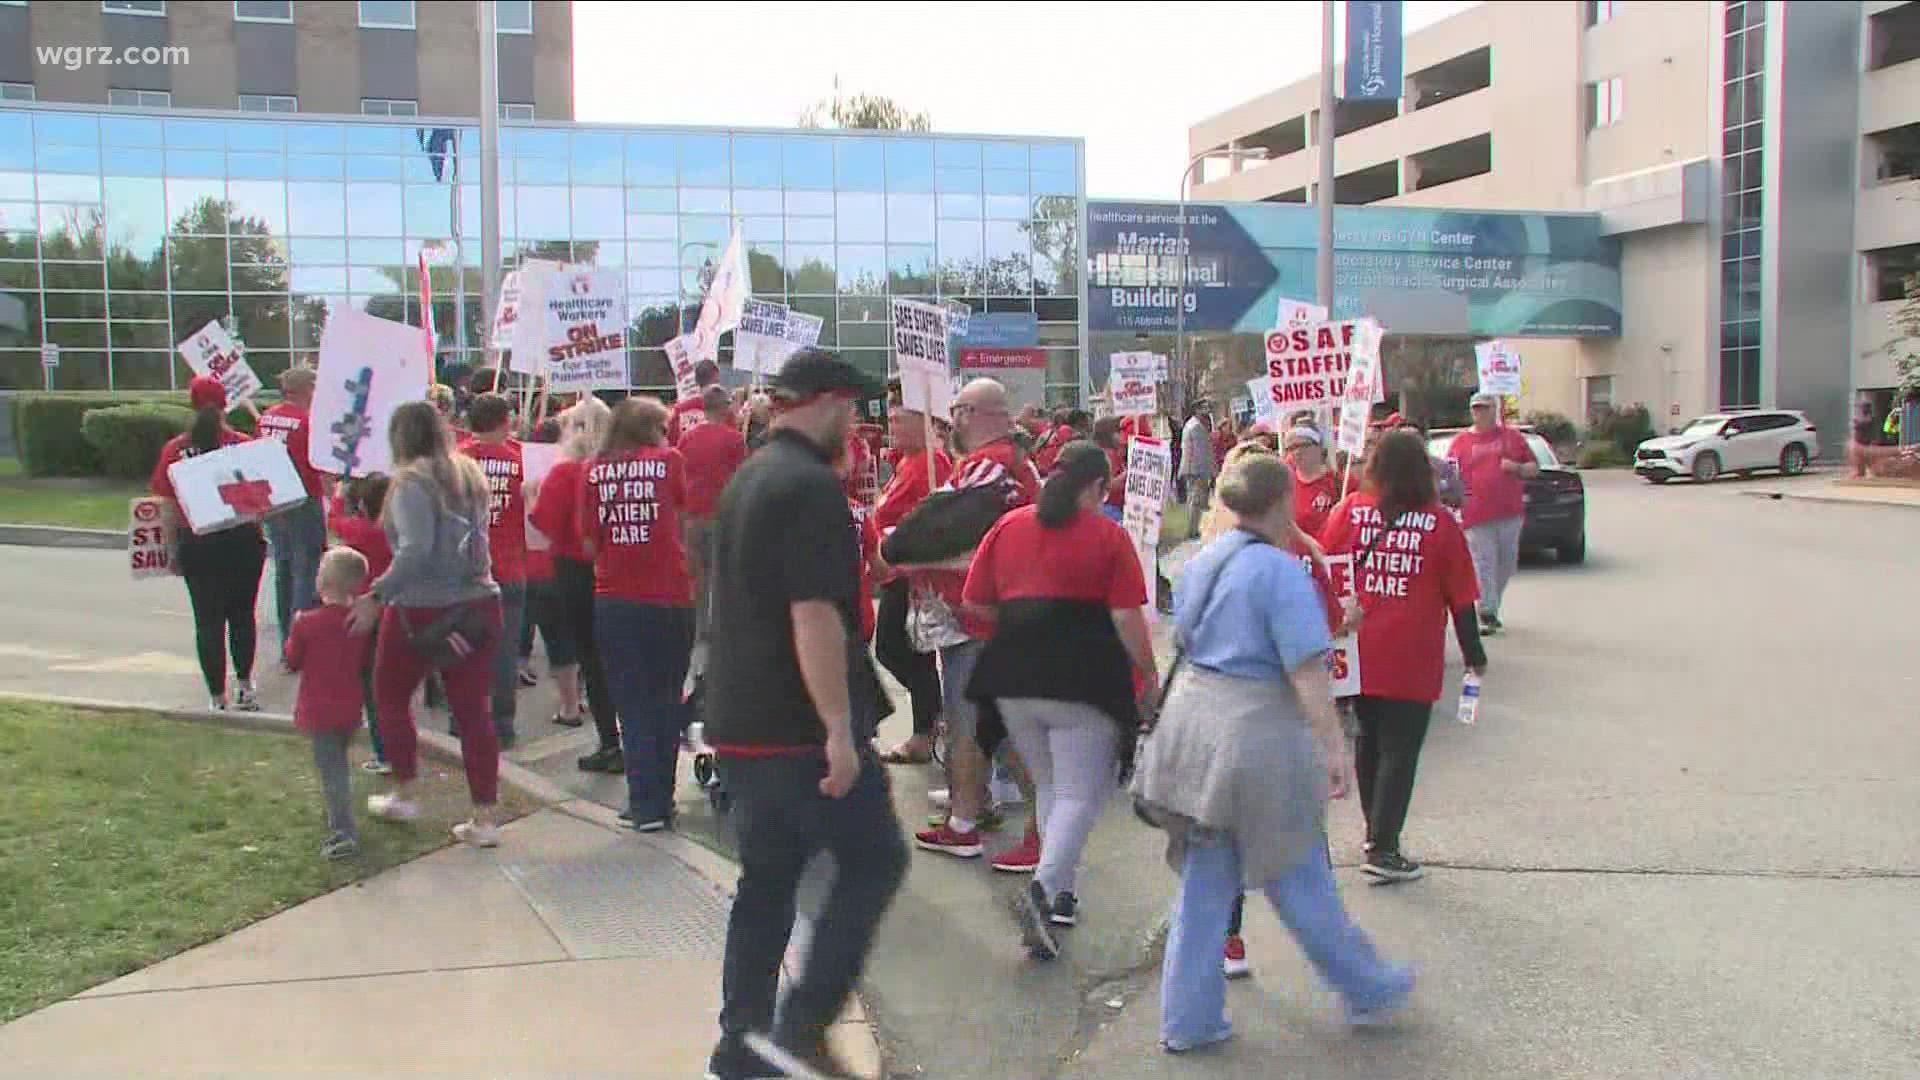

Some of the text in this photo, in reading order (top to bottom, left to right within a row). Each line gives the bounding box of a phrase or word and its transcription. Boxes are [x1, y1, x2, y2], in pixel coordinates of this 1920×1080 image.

[1201, 213, 1217, 225] the
[1117, 232, 1190, 254] Marian
[1431, 231, 1476, 245] Center
[1464, 256, 1512, 270] Center
[549, 298, 613, 311] Healthcare
[557, 310, 606, 322] Workers
[566, 322, 598, 342] ON
[740, 317, 763, 333] SAVES
[764, 319, 785, 337] LIVES
[549, 333, 622, 361] STRIKE
[897, 331, 945, 364] SAVES LIVES
[1292, 325, 1355, 352] SAF
[980, 352, 1033, 365] Emergency
[1269, 352, 1351, 378] STAFFI
[1272, 380, 1325, 403] SAVES
[589, 460, 666, 483] STANDING
[488, 476, 509, 491] OR
[599, 481, 655, 502] UP FOR
[1128, 474, 1162, 500] SAVES LIVES
[599, 502, 661, 524] PATIENT
[1351, 505, 1437, 532] STAING
[612, 526, 650, 544] CARE
[1386, 530, 1422, 552] FOR
[132, 550, 168, 569] SAV
[1365, 574, 1409, 596] CARE
